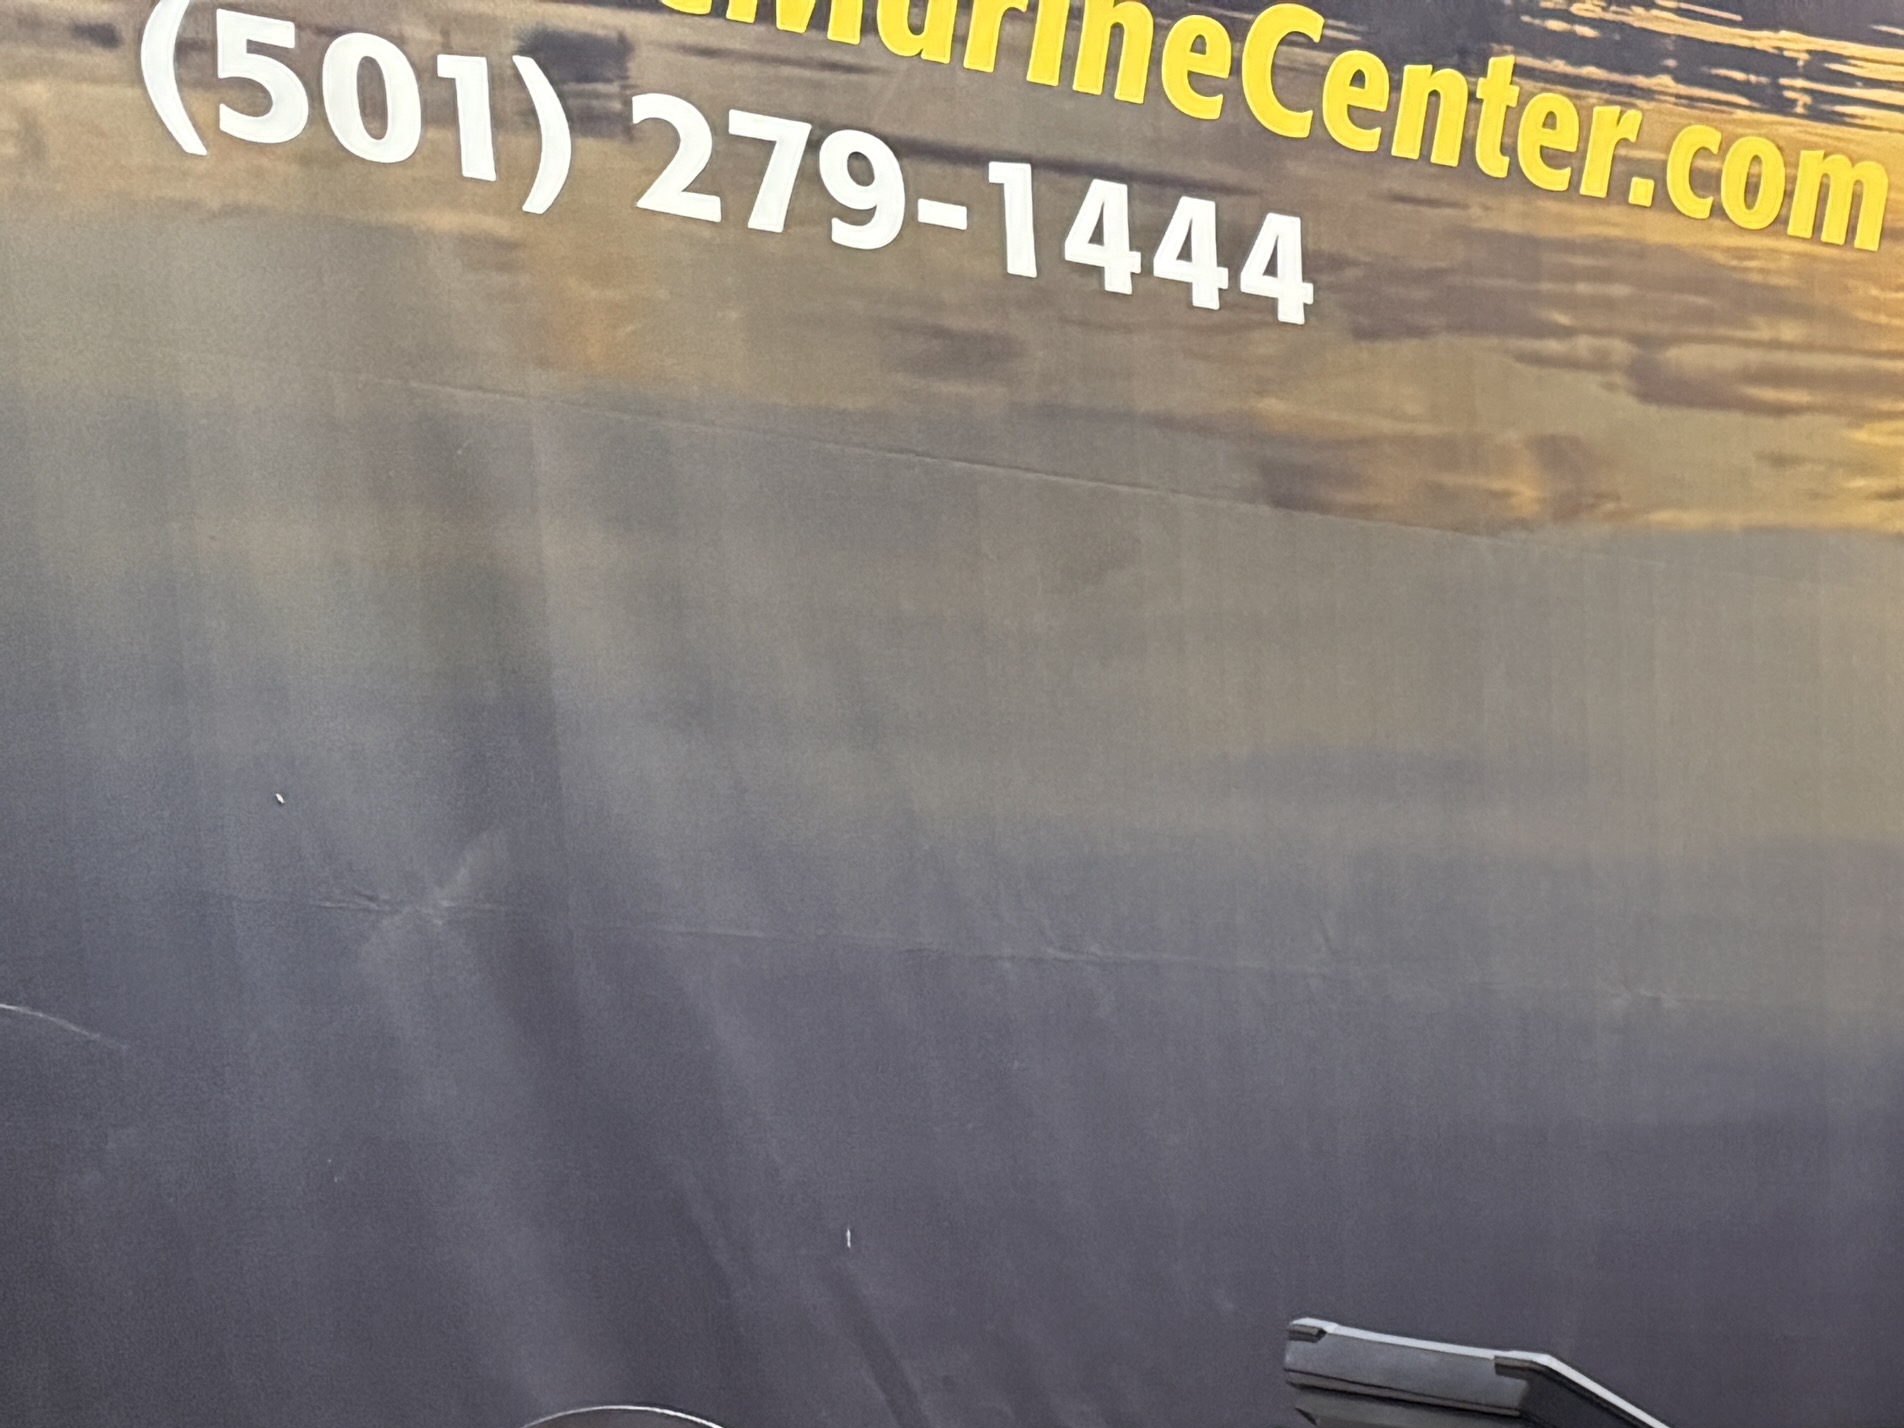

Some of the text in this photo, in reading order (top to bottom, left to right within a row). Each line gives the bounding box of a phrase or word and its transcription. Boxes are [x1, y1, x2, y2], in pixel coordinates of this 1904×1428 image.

[140, 0, 1317, 326] (501) 279-1444
[660, 0, 1889, 253] arineCenter.com
